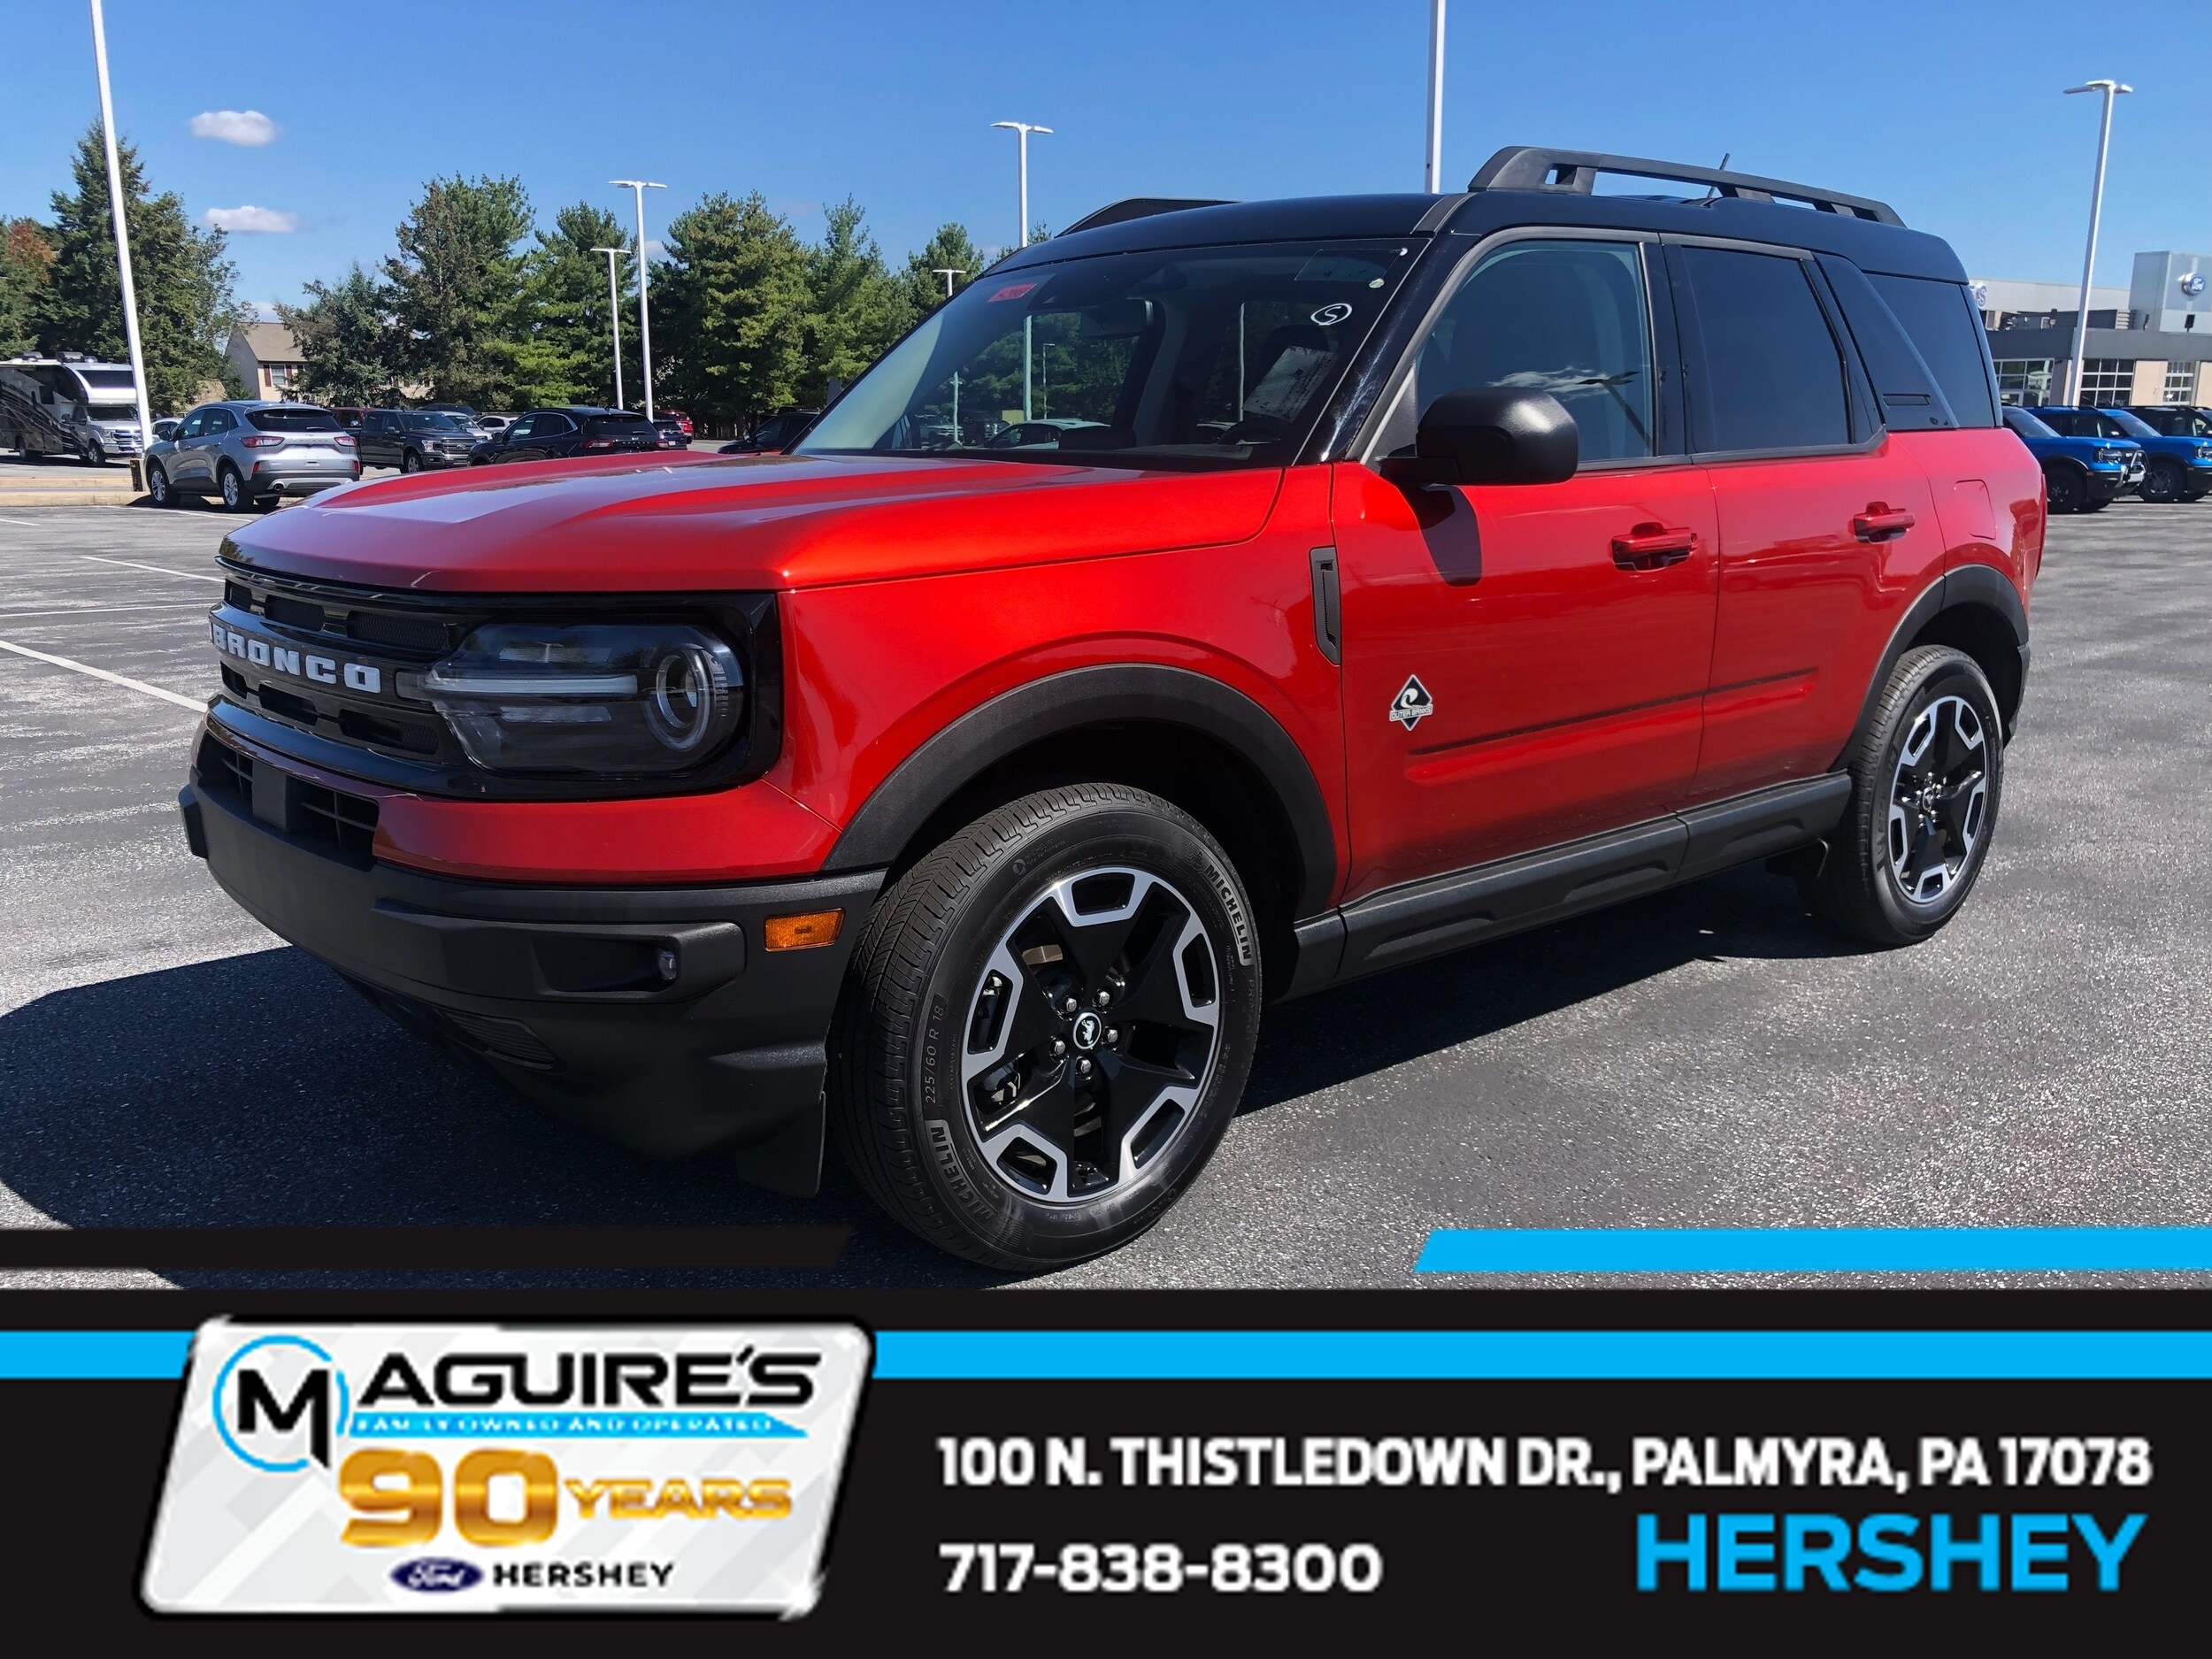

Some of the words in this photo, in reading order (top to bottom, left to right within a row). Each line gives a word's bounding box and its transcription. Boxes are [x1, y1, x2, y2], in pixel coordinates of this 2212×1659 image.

[212, 623, 381, 694] BRONCO
[1391, 710, 1411, 719] OUTER
[1411, 707, 1432, 716] BANKS
[1204, 864, 1252, 960] MICHELIN
[928, 1028, 940, 1041] R
[933, 1005, 943, 1021] 18
[925, 1045, 937, 1104] 225/60
[930, 1126, 995, 1220] MICHELIN
